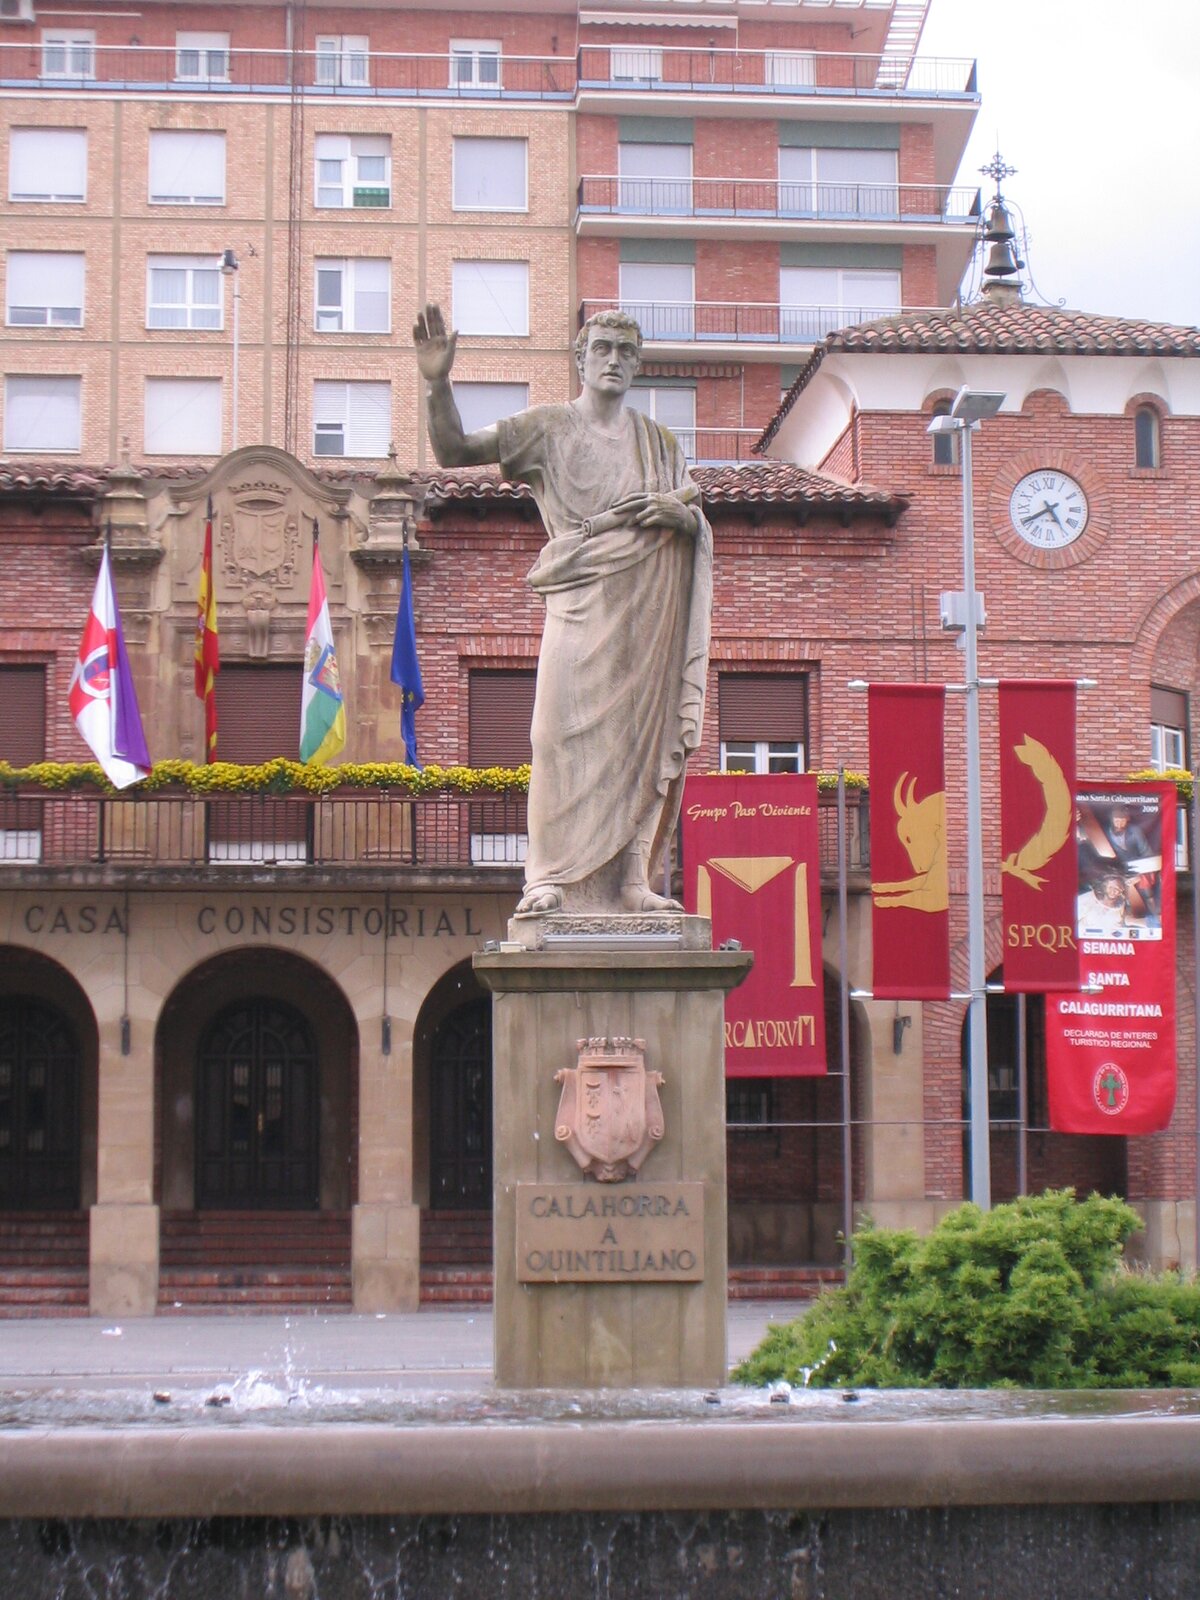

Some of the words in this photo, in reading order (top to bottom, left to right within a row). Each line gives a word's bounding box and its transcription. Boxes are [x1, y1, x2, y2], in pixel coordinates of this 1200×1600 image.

[1090, 794, 1110, 803] Santa
[1111, 795, 1159, 804] Calagurritana
[687, 804, 728, 822] Grupo
[729, 801, 757, 819] Paso
[758, 803, 812, 817] Viviente
[1142, 805, 1159, 813] 2009
[24, 905, 128, 935] CASA
[197, 906, 483, 938] CONSISTORIAL
[1008, 923, 1078, 954] SPQR
[1082, 941, 1136, 956] SEMANA
[1088, 971, 1131, 986] SANTA
[1059, 1001, 1163, 1018] CALAGURRITANA
[1063, 1029, 1110, 1039] DECLARADA
[1110, 1031, 1122, 1040] DE
[1123, 1032, 1158, 1041] INTERES
[1069, 1038, 1110, 1048] TURISTICO
[1110, 1040, 1152, 1049] REGIONAL
[530, 1195, 690, 1219] CALAHORRA
[600, 1223, 618, 1245] A
